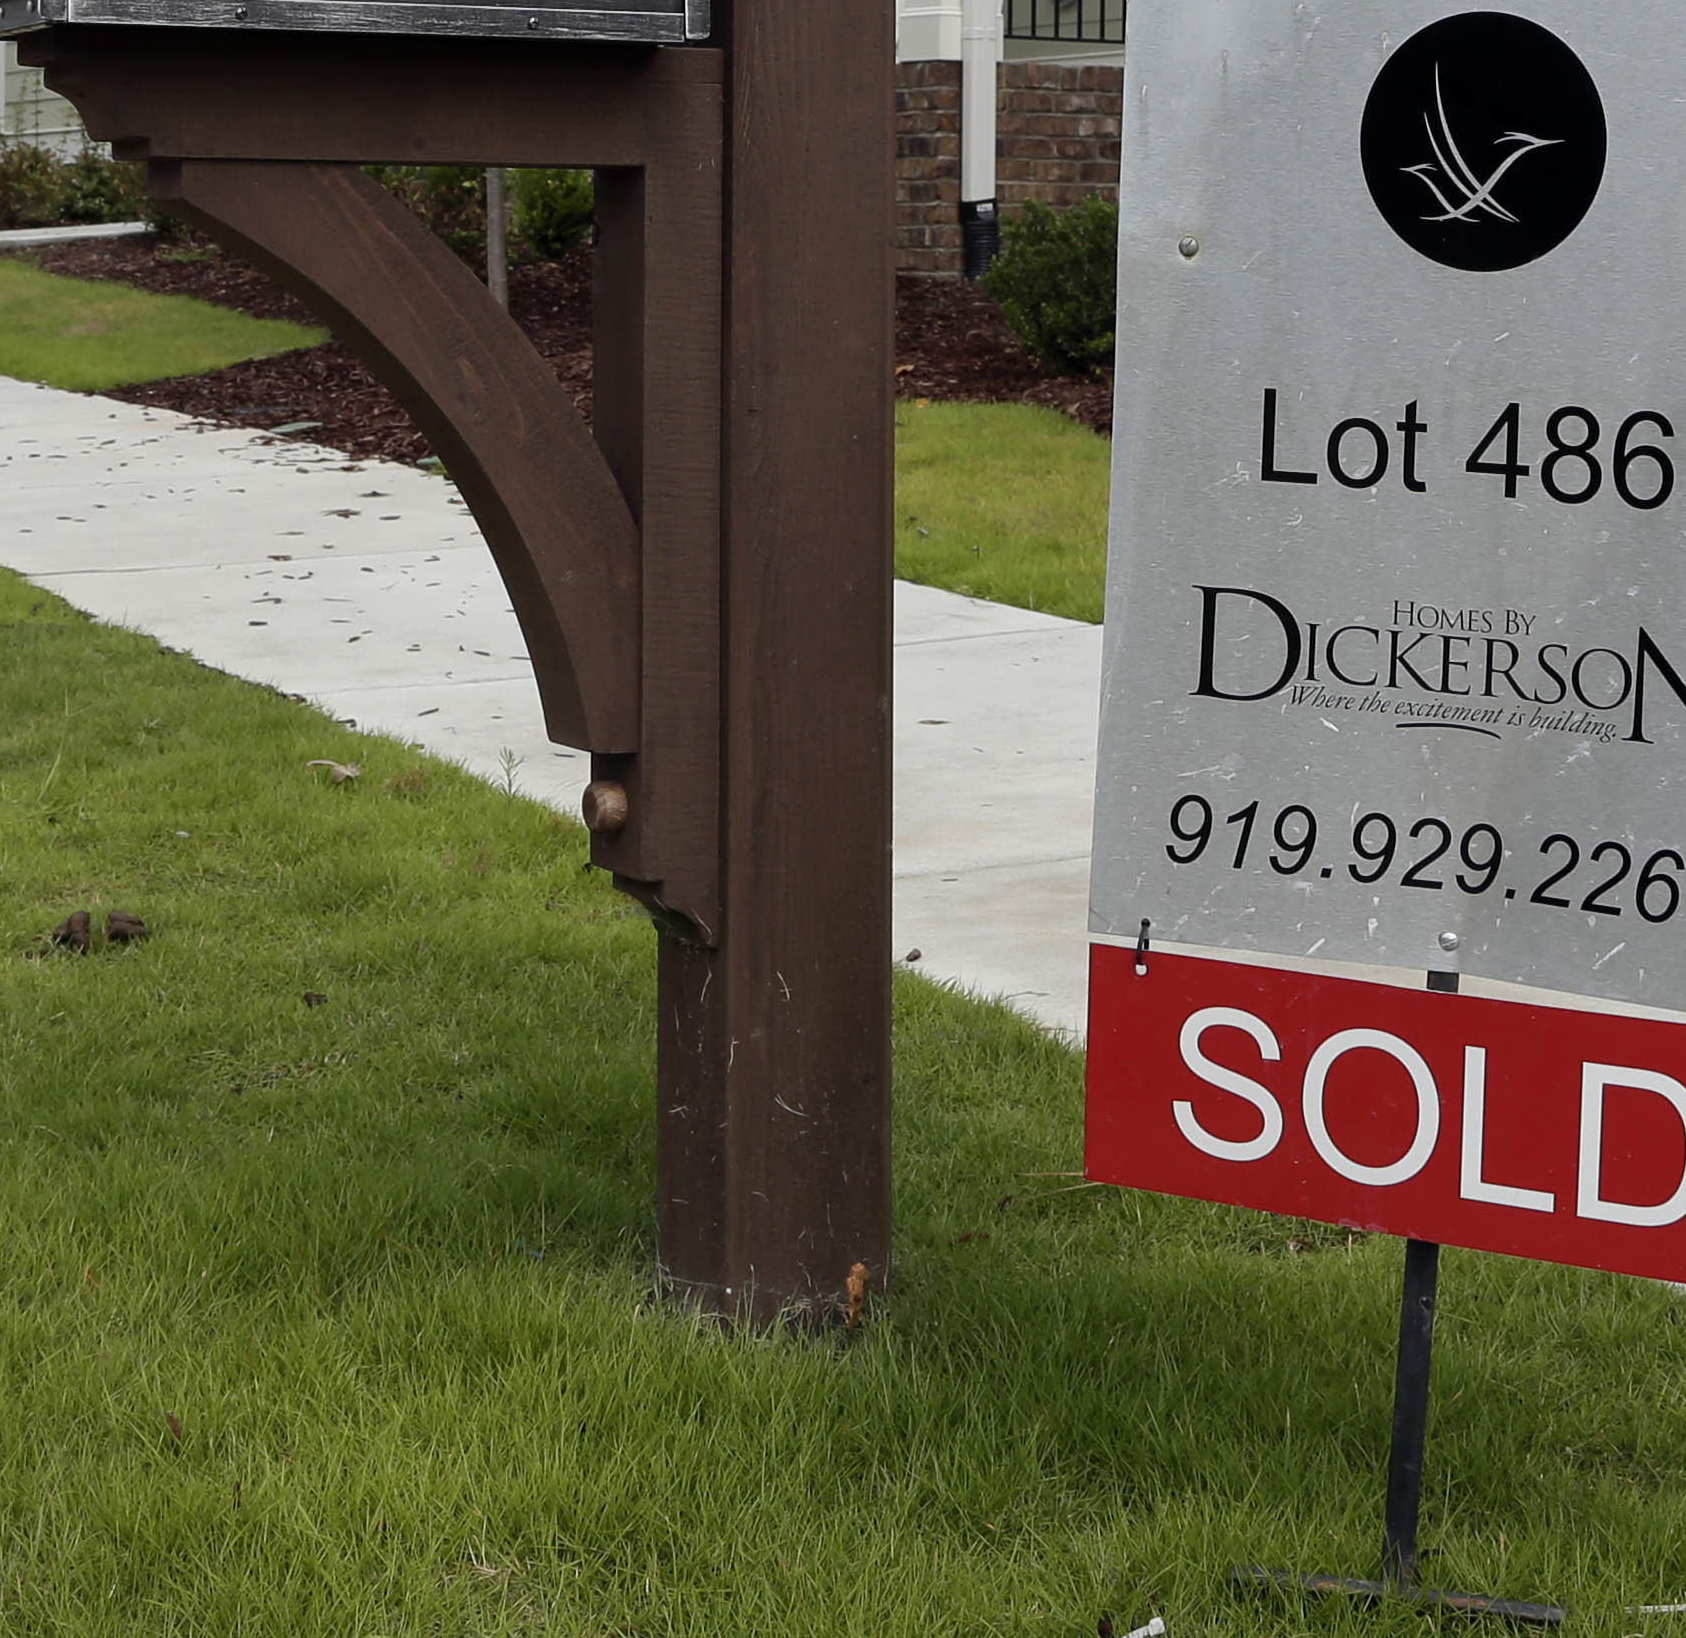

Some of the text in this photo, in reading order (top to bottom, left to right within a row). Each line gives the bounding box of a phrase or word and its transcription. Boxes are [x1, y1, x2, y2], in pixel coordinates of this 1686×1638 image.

[1259, 388, 1676, 510] Lot 486
[1393, 600, 1493, 634] HOMES
[1289, 684, 1355, 712] Where
[1358, 692, 1391, 713] the
[1394, 698, 1503, 724] excitement
[1508, 705, 1525, 727] is
